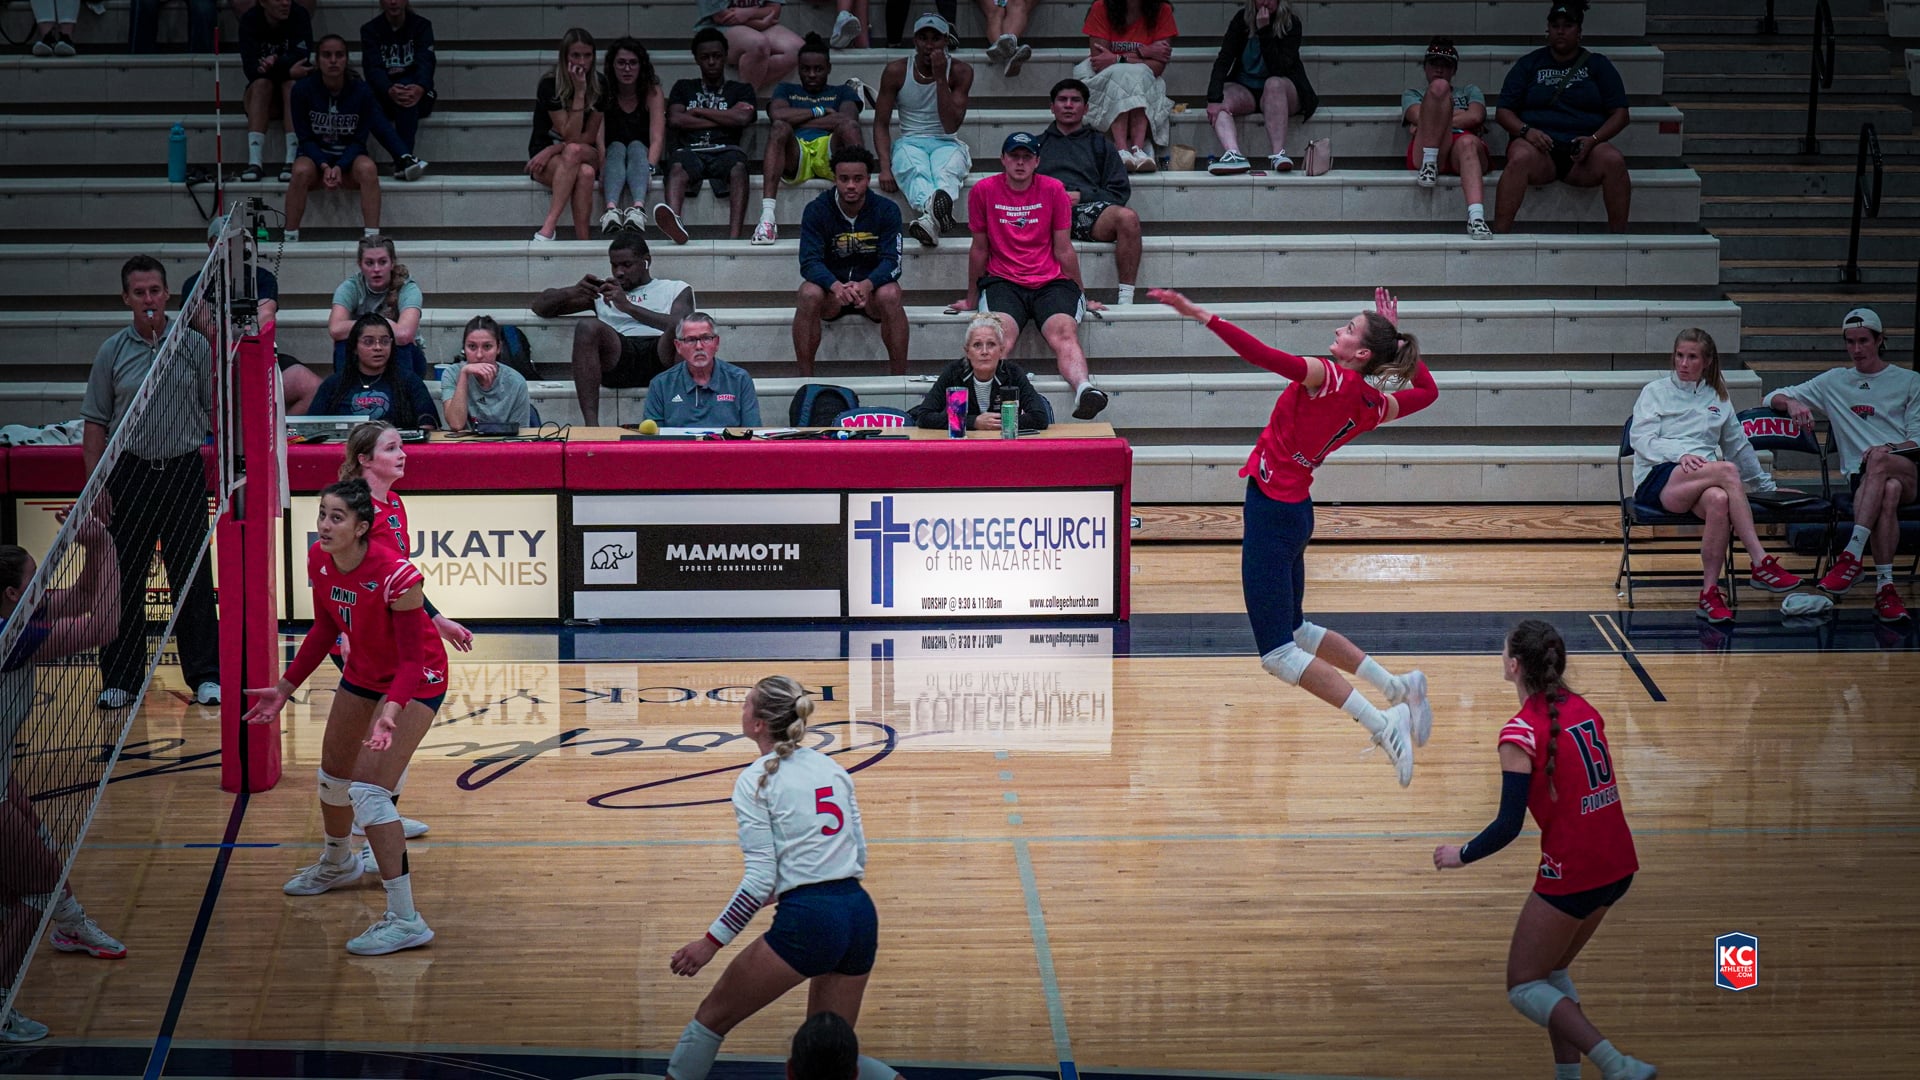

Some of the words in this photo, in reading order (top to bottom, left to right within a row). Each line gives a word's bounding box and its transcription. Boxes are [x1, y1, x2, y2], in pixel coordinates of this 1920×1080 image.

[1741, 416, 1801, 439] MNU
[409, 530, 546, 558] UKATY
[665, 543, 800, 561] MAMMOTH
[717, 564, 784, 572] CONSTRUCTION
[925, 551, 940, 571] of
[948, 550, 973, 570] the
[980, 549, 1062, 571] NAZARENE
[421, 561, 547, 586] MPANIES
[330, 585, 358, 606] MNU
[921, 597, 948, 610] WORSHIP
[948, 596, 957, 611] @
[958, 597, 971, 609] 9:30
[972, 597, 977, 609] &
[978, 597, 1003, 609] 11:00am
[1029, 596, 1099, 611] www.collegechurch.com
[1564, 719, 1612, 791] 13
[814, 785, 844, 837] 5
